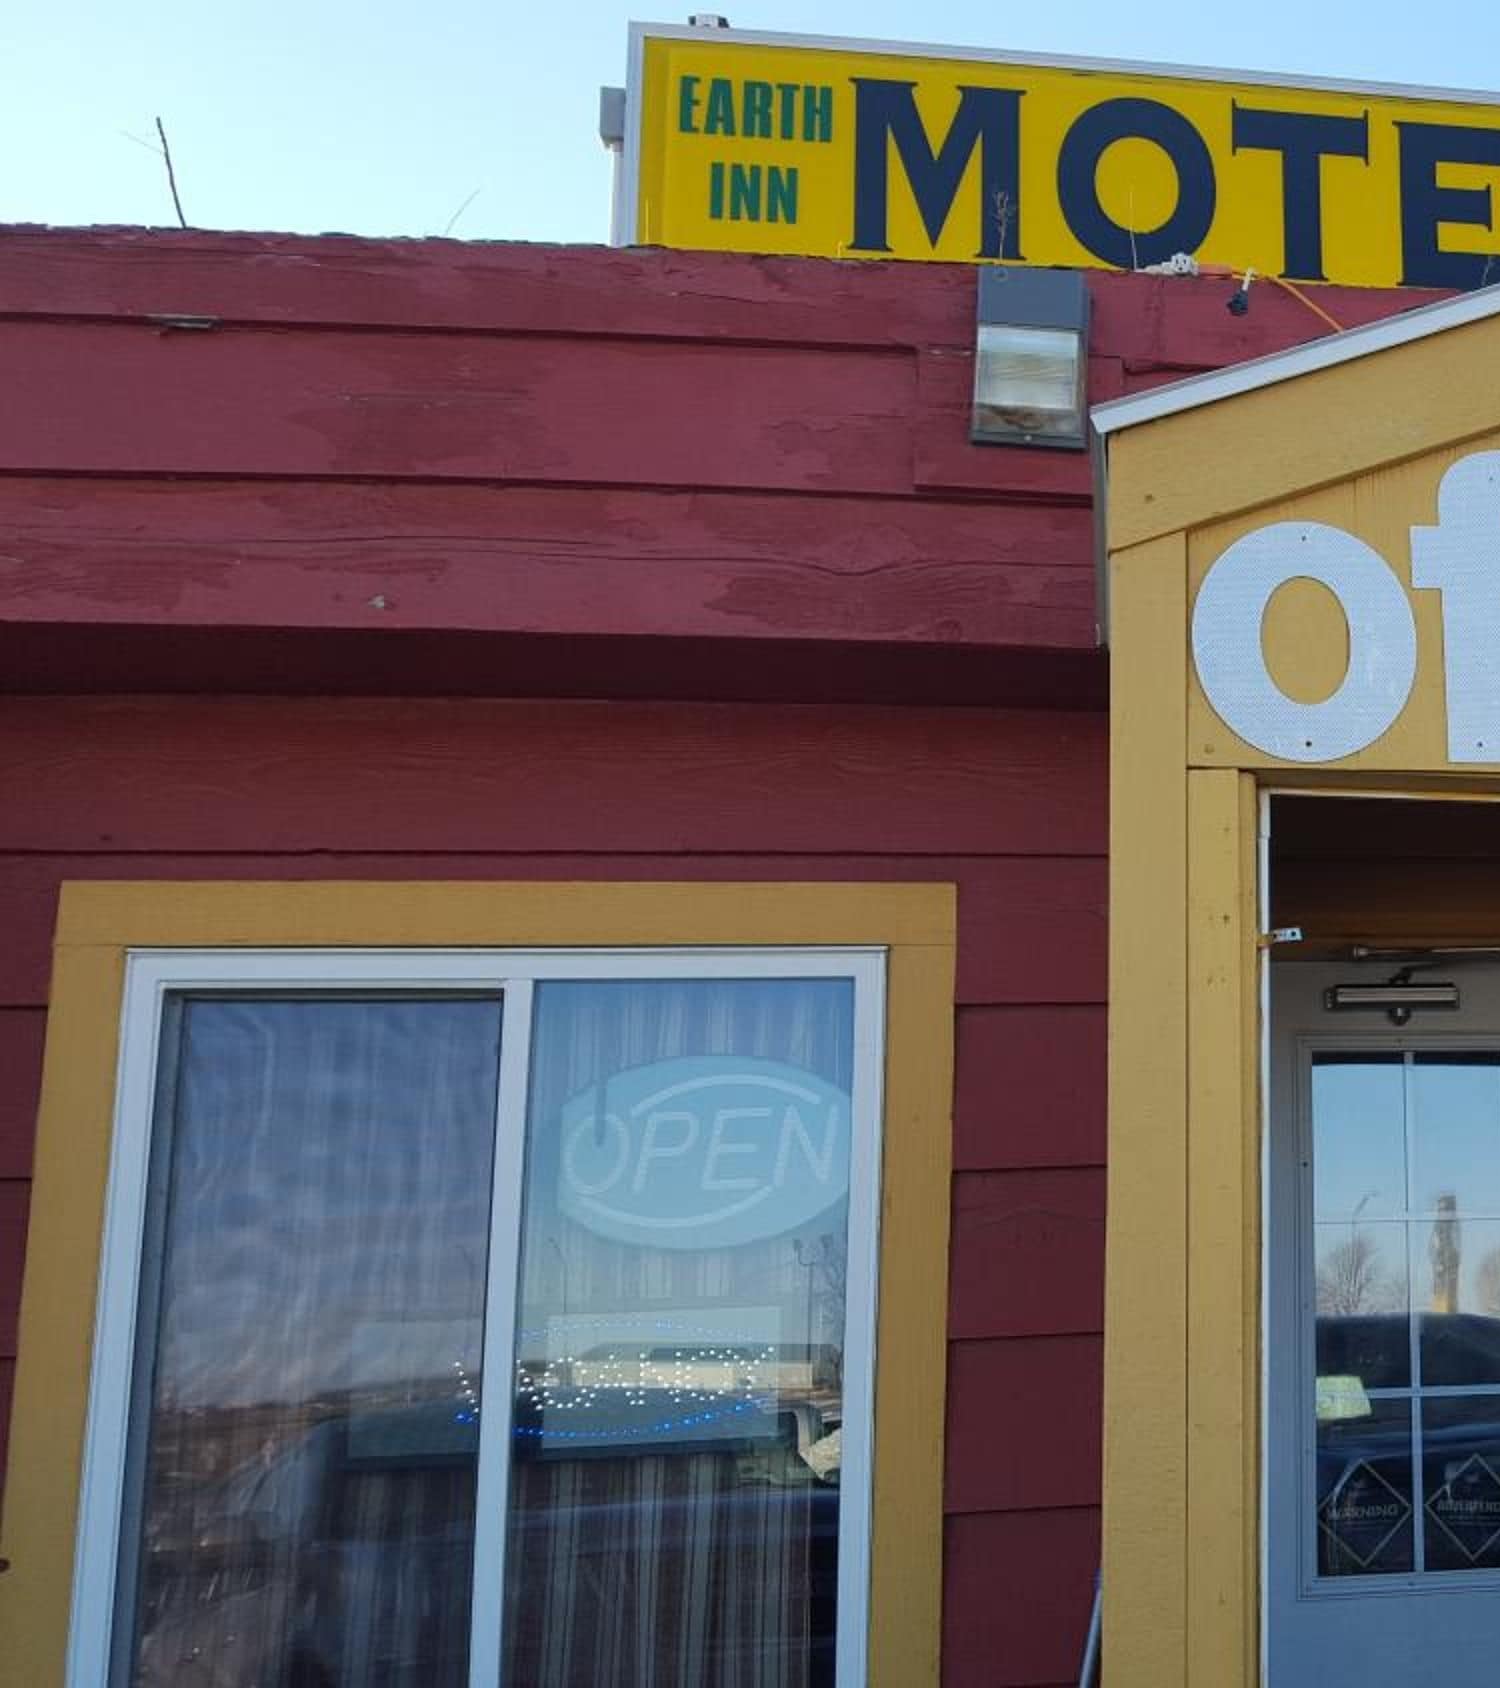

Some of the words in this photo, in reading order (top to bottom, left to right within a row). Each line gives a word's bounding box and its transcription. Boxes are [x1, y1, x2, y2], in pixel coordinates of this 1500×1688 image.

[679, 75, 833, 143] EARTH
[709, 161, 798, 225] INN
[564, 1104, 839, 1195] OPEN
[1326, 1503, 1399, 1520] WARNING
